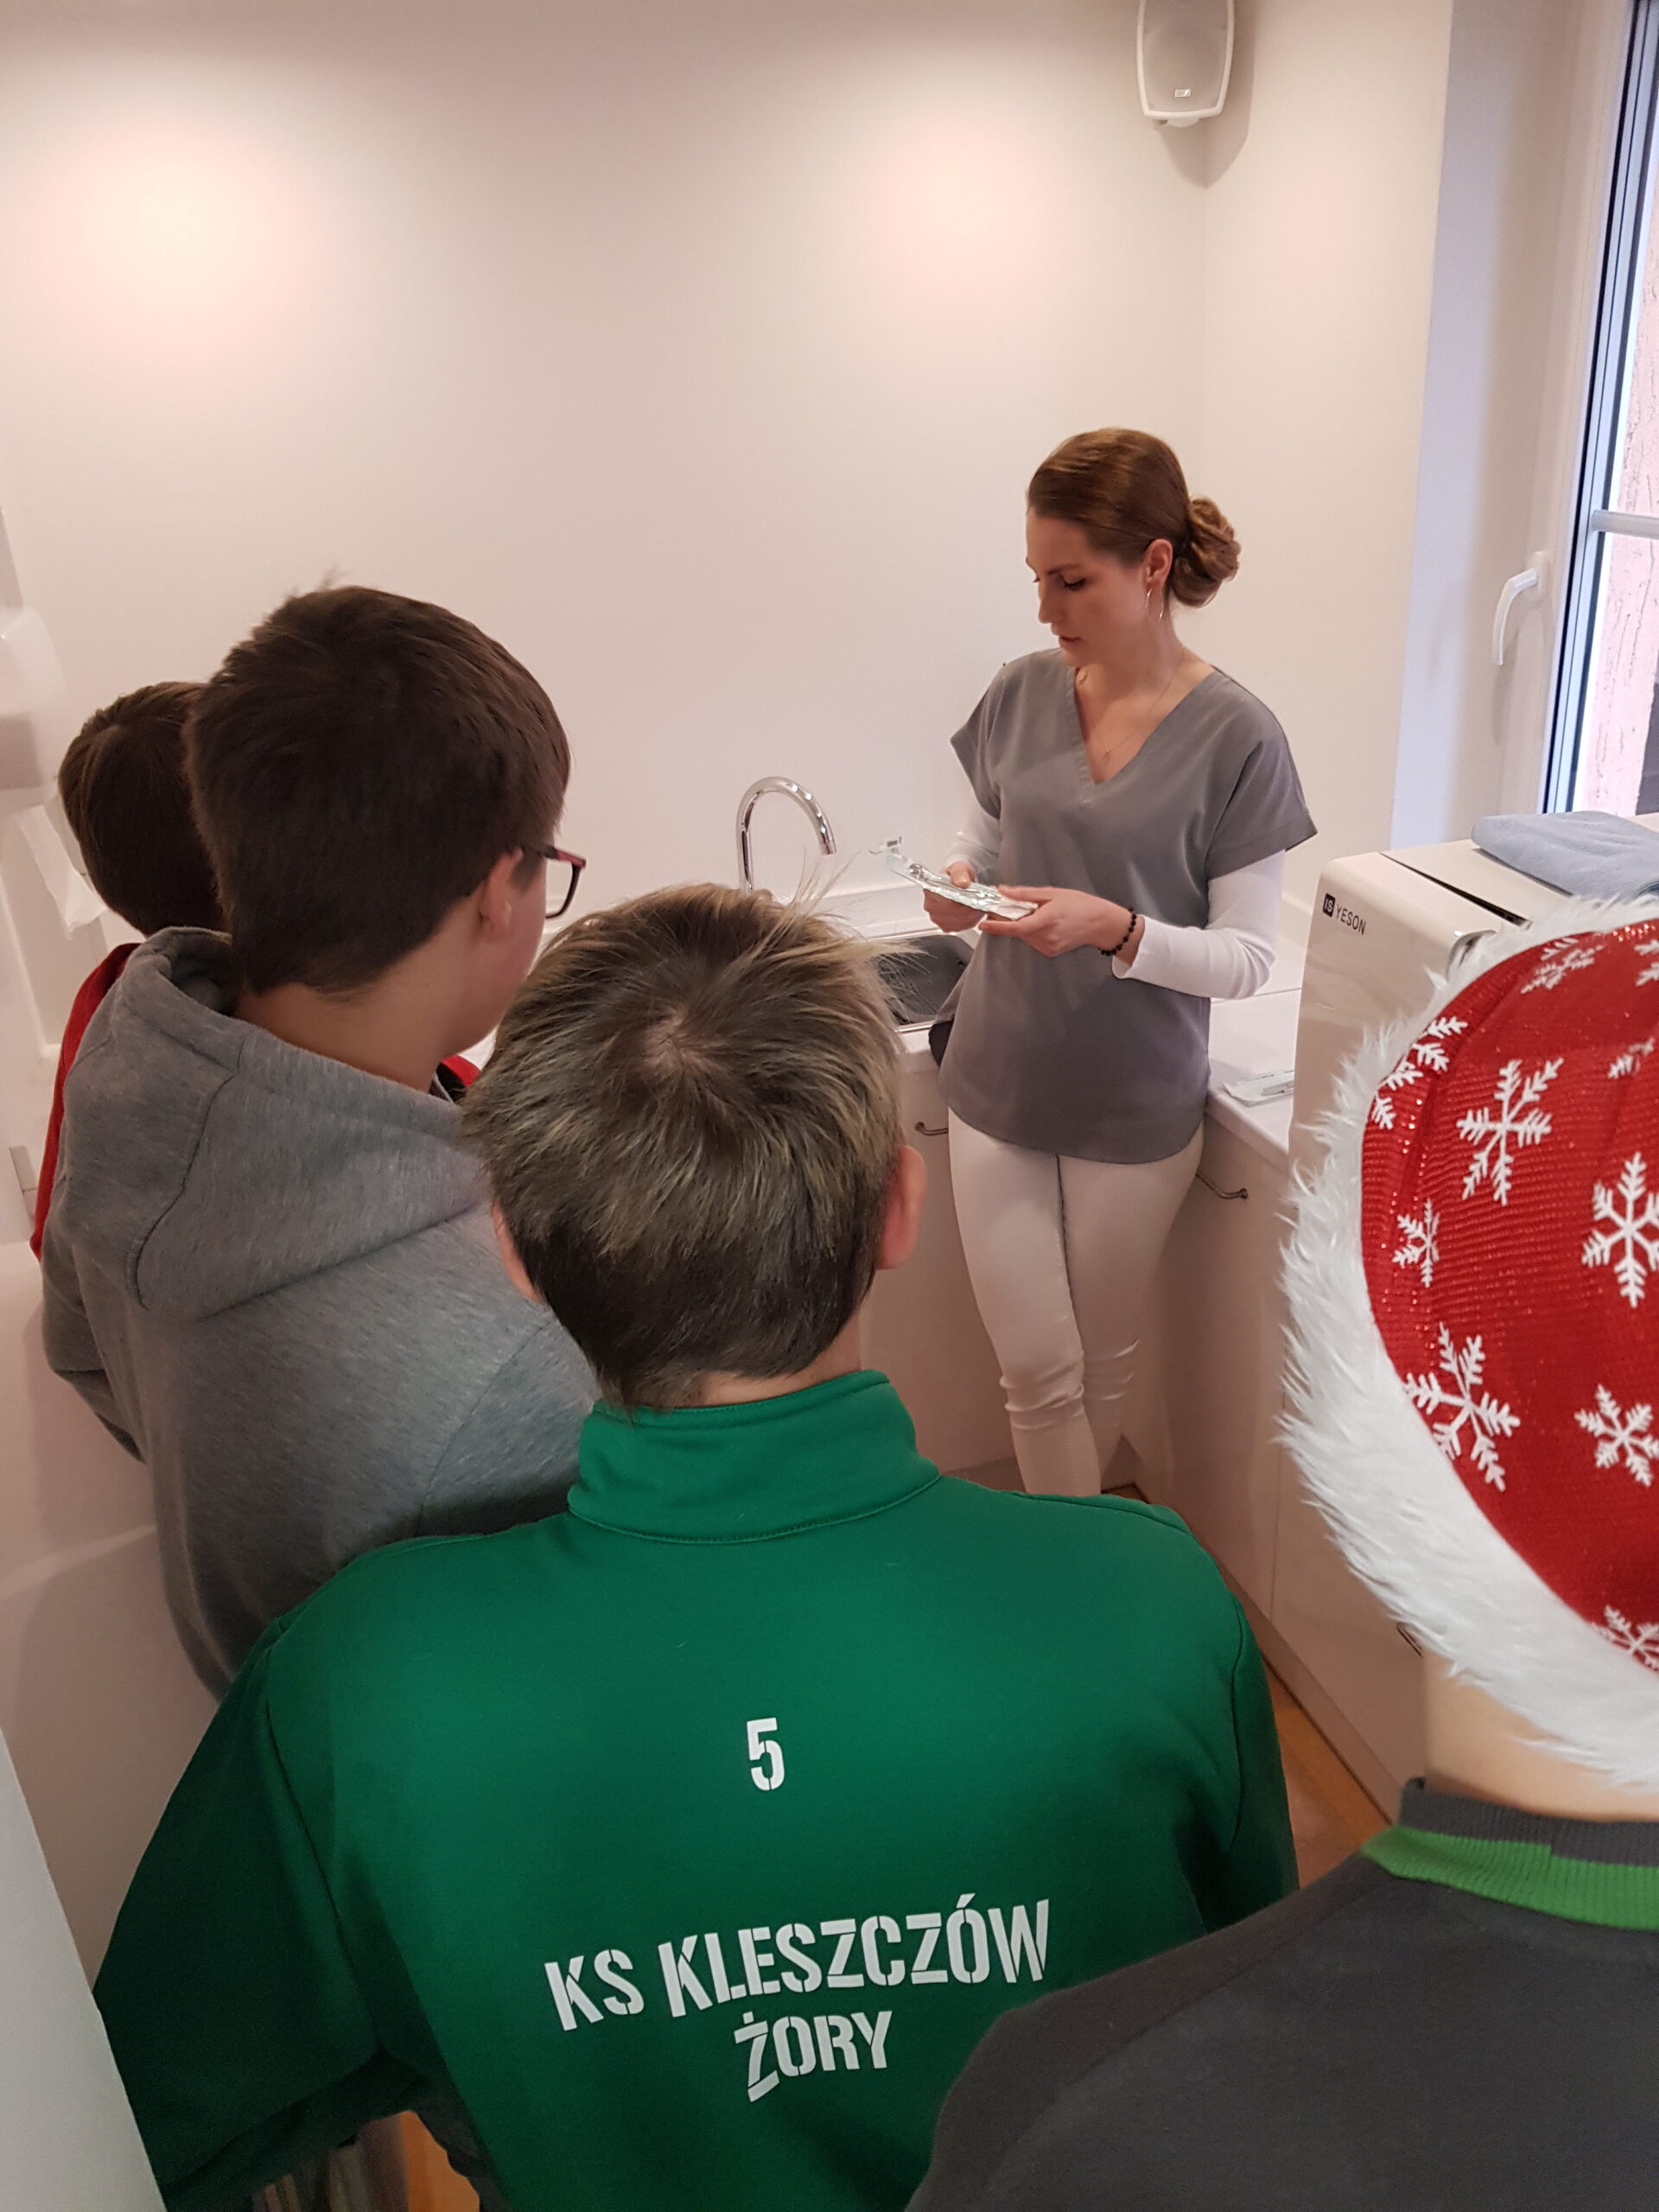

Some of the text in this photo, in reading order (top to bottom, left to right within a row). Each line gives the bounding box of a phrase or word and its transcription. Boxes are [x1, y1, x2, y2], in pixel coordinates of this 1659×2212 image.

[1336, 903, 1366, 935] YESON
[746, 1717, 785, 1791] 5
[544, 1893, 1049, 2031] KS KLESZCZÓW
[734, 2011, 893, 2102] ŻORY
